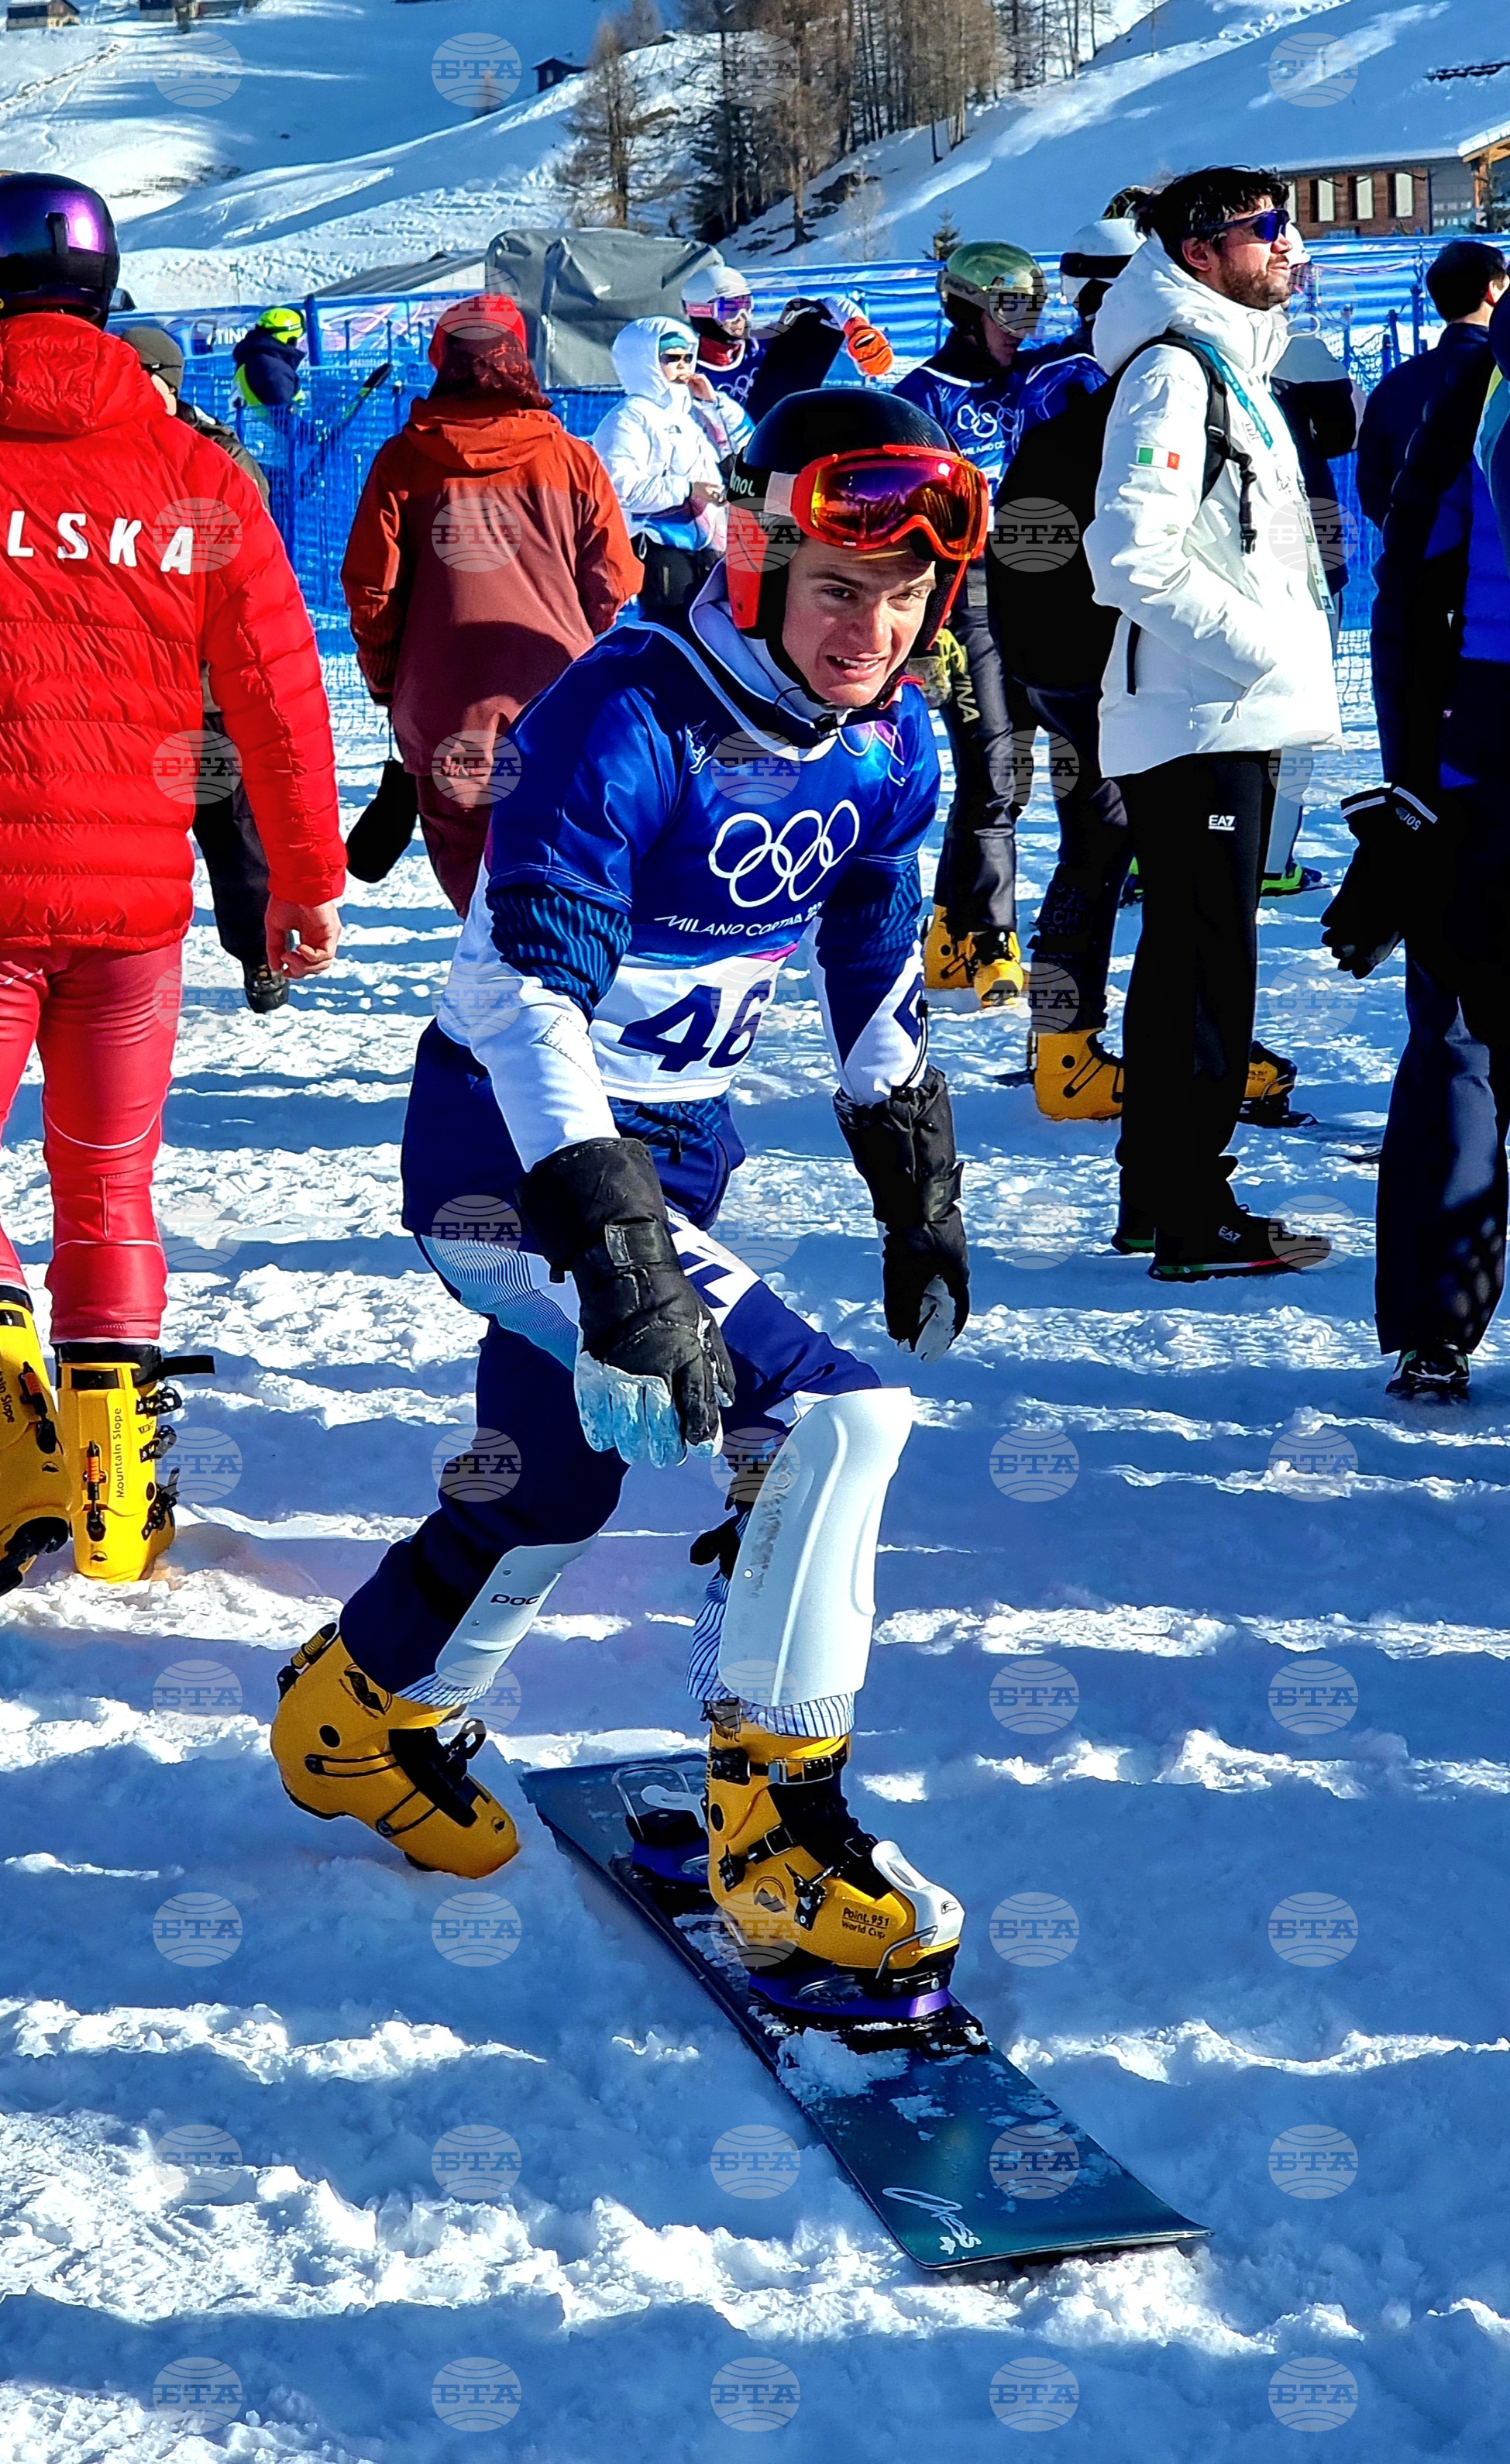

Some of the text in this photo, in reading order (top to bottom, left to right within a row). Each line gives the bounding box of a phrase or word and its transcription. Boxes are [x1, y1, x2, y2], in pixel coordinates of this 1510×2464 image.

[7, 510, 193, 576] LSKA
[1209, 814, 1236, 828] EA7
[654, 915, 745, 936] MILANO
[617, 979, 772, 1073] 46
[1219, 1225, 1241, 1241] EA7
[1, 1394, 15, 1423] Slope
[113, 1408, 125, 1498] Mountain Slope
[842, 1919, 865, 1934] World
